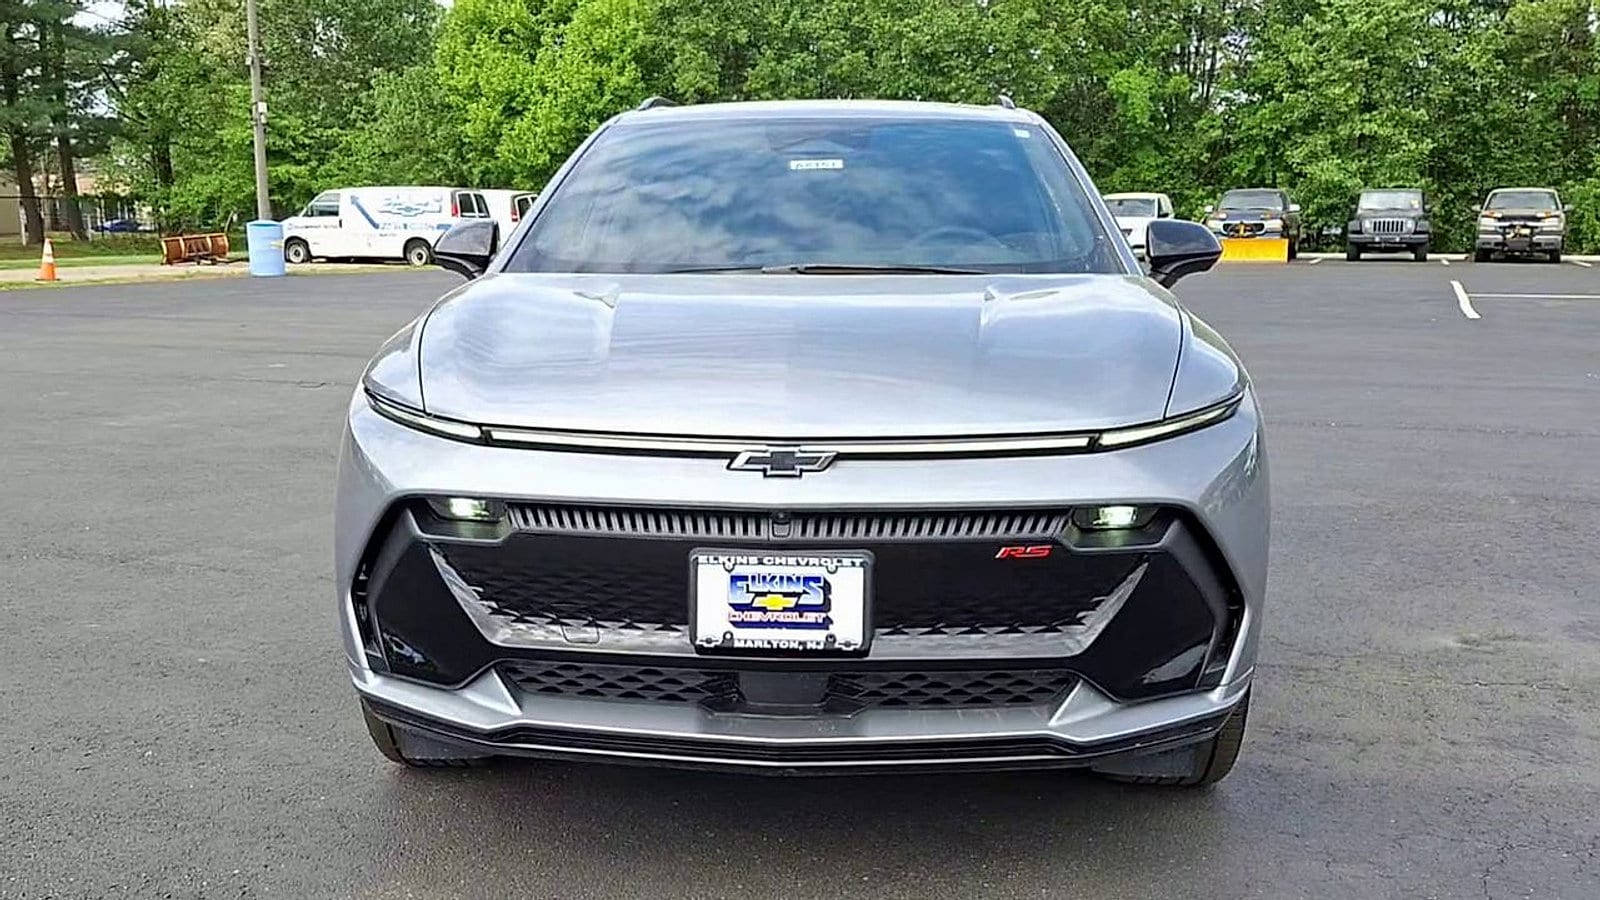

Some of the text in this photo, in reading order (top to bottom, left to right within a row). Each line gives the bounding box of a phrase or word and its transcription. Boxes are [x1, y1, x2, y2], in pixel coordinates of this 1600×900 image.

[994, 545, 1053, 559] RS
[698, 556, 863, 567] ELKINS CHEVROLET
[728, 574, 825, 605] ELKINS
[728, 611, 826, 623] CHEVROLET
[734, 639, 825, 650] MARLTON, NJ
